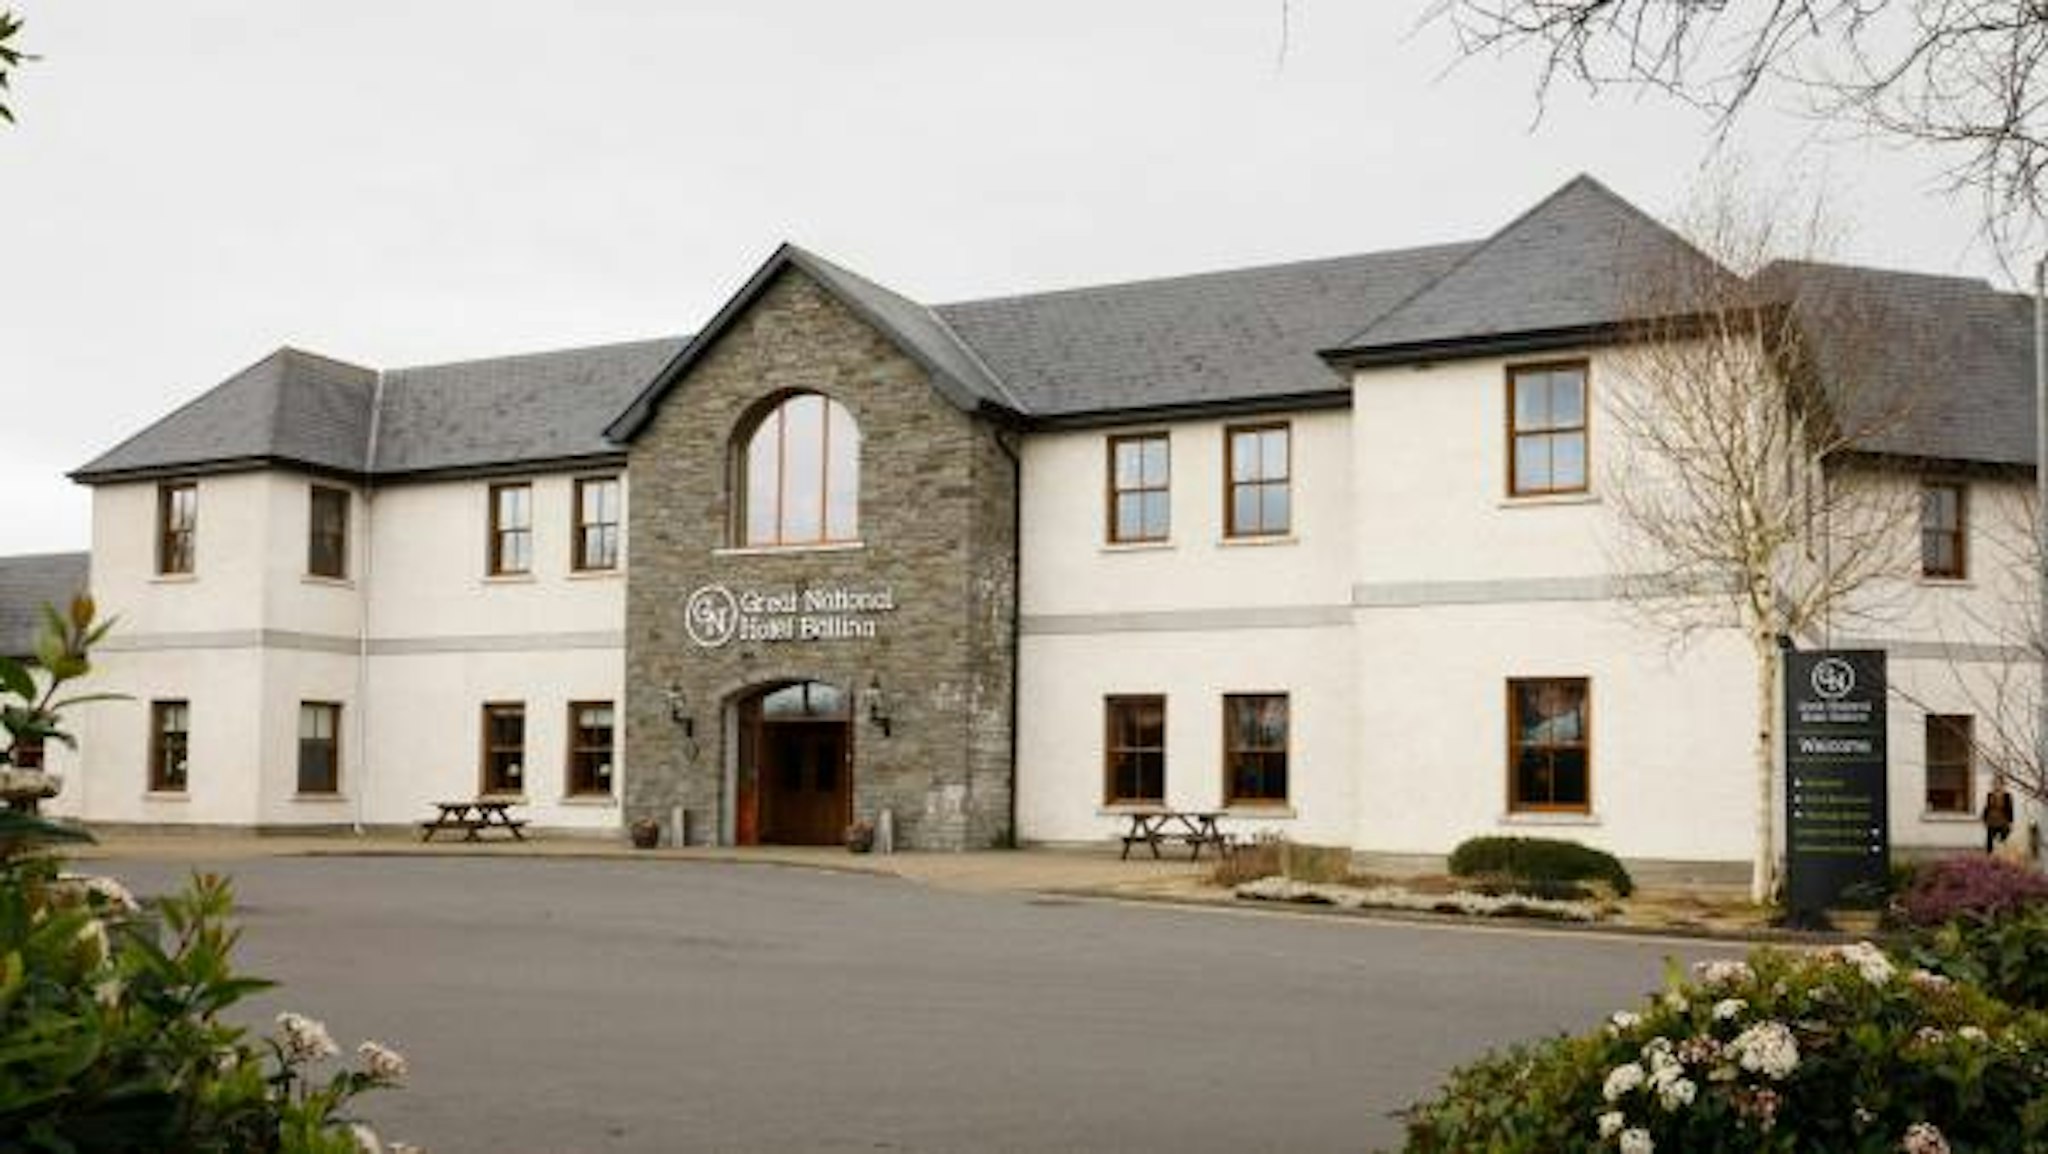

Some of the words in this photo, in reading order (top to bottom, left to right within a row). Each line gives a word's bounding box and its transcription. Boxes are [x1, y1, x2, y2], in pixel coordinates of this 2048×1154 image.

[740, 588, 797, 612] Great
[804, 587, 893, 611] National
[739, 615, 795, 640] Hotel
[801, 615, 876, 638] Ballina
